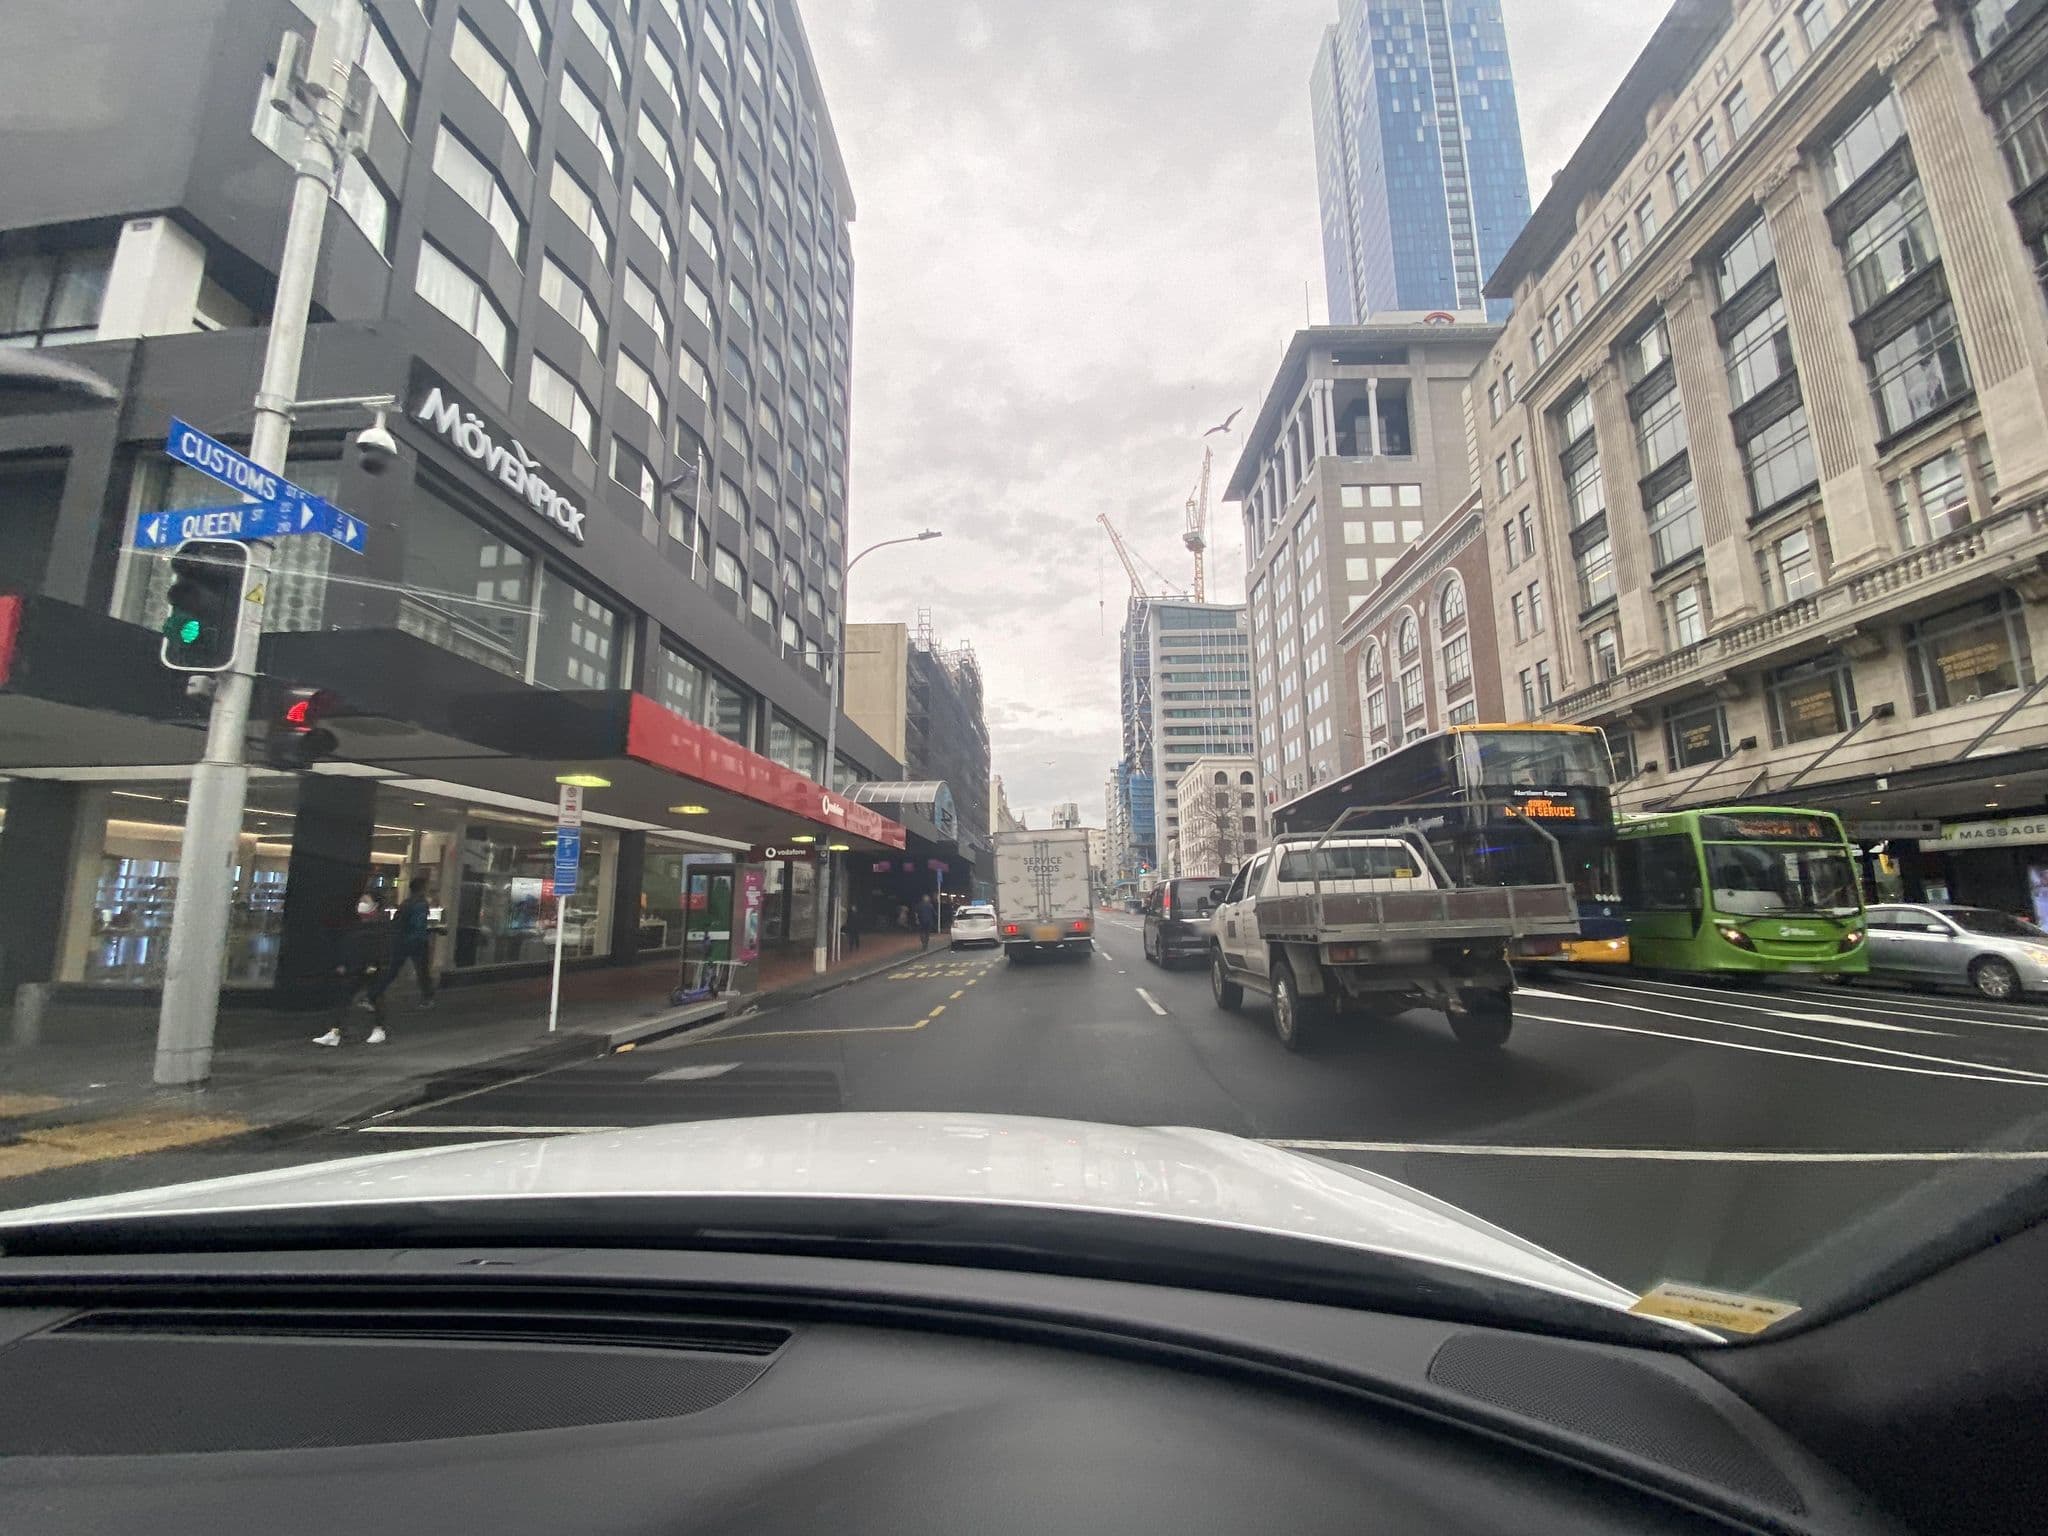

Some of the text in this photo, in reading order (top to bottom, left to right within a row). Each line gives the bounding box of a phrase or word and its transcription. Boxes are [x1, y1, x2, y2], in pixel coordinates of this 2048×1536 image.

[181, 431, 277, 501] CUSTOMS
[418, 387, 585, 541] MÖVENPICK
[182, 508, 264, 538] QUEEN ST
[1538, 807, 1576, 816] SERVICE
[1959, 824, 2047, 841] MASSAGE
[776, 848, 807, 857] vodafone
[1023, 856, 1063, 866] SERVICE
[1026, 864, 1060, 873] FOODS
